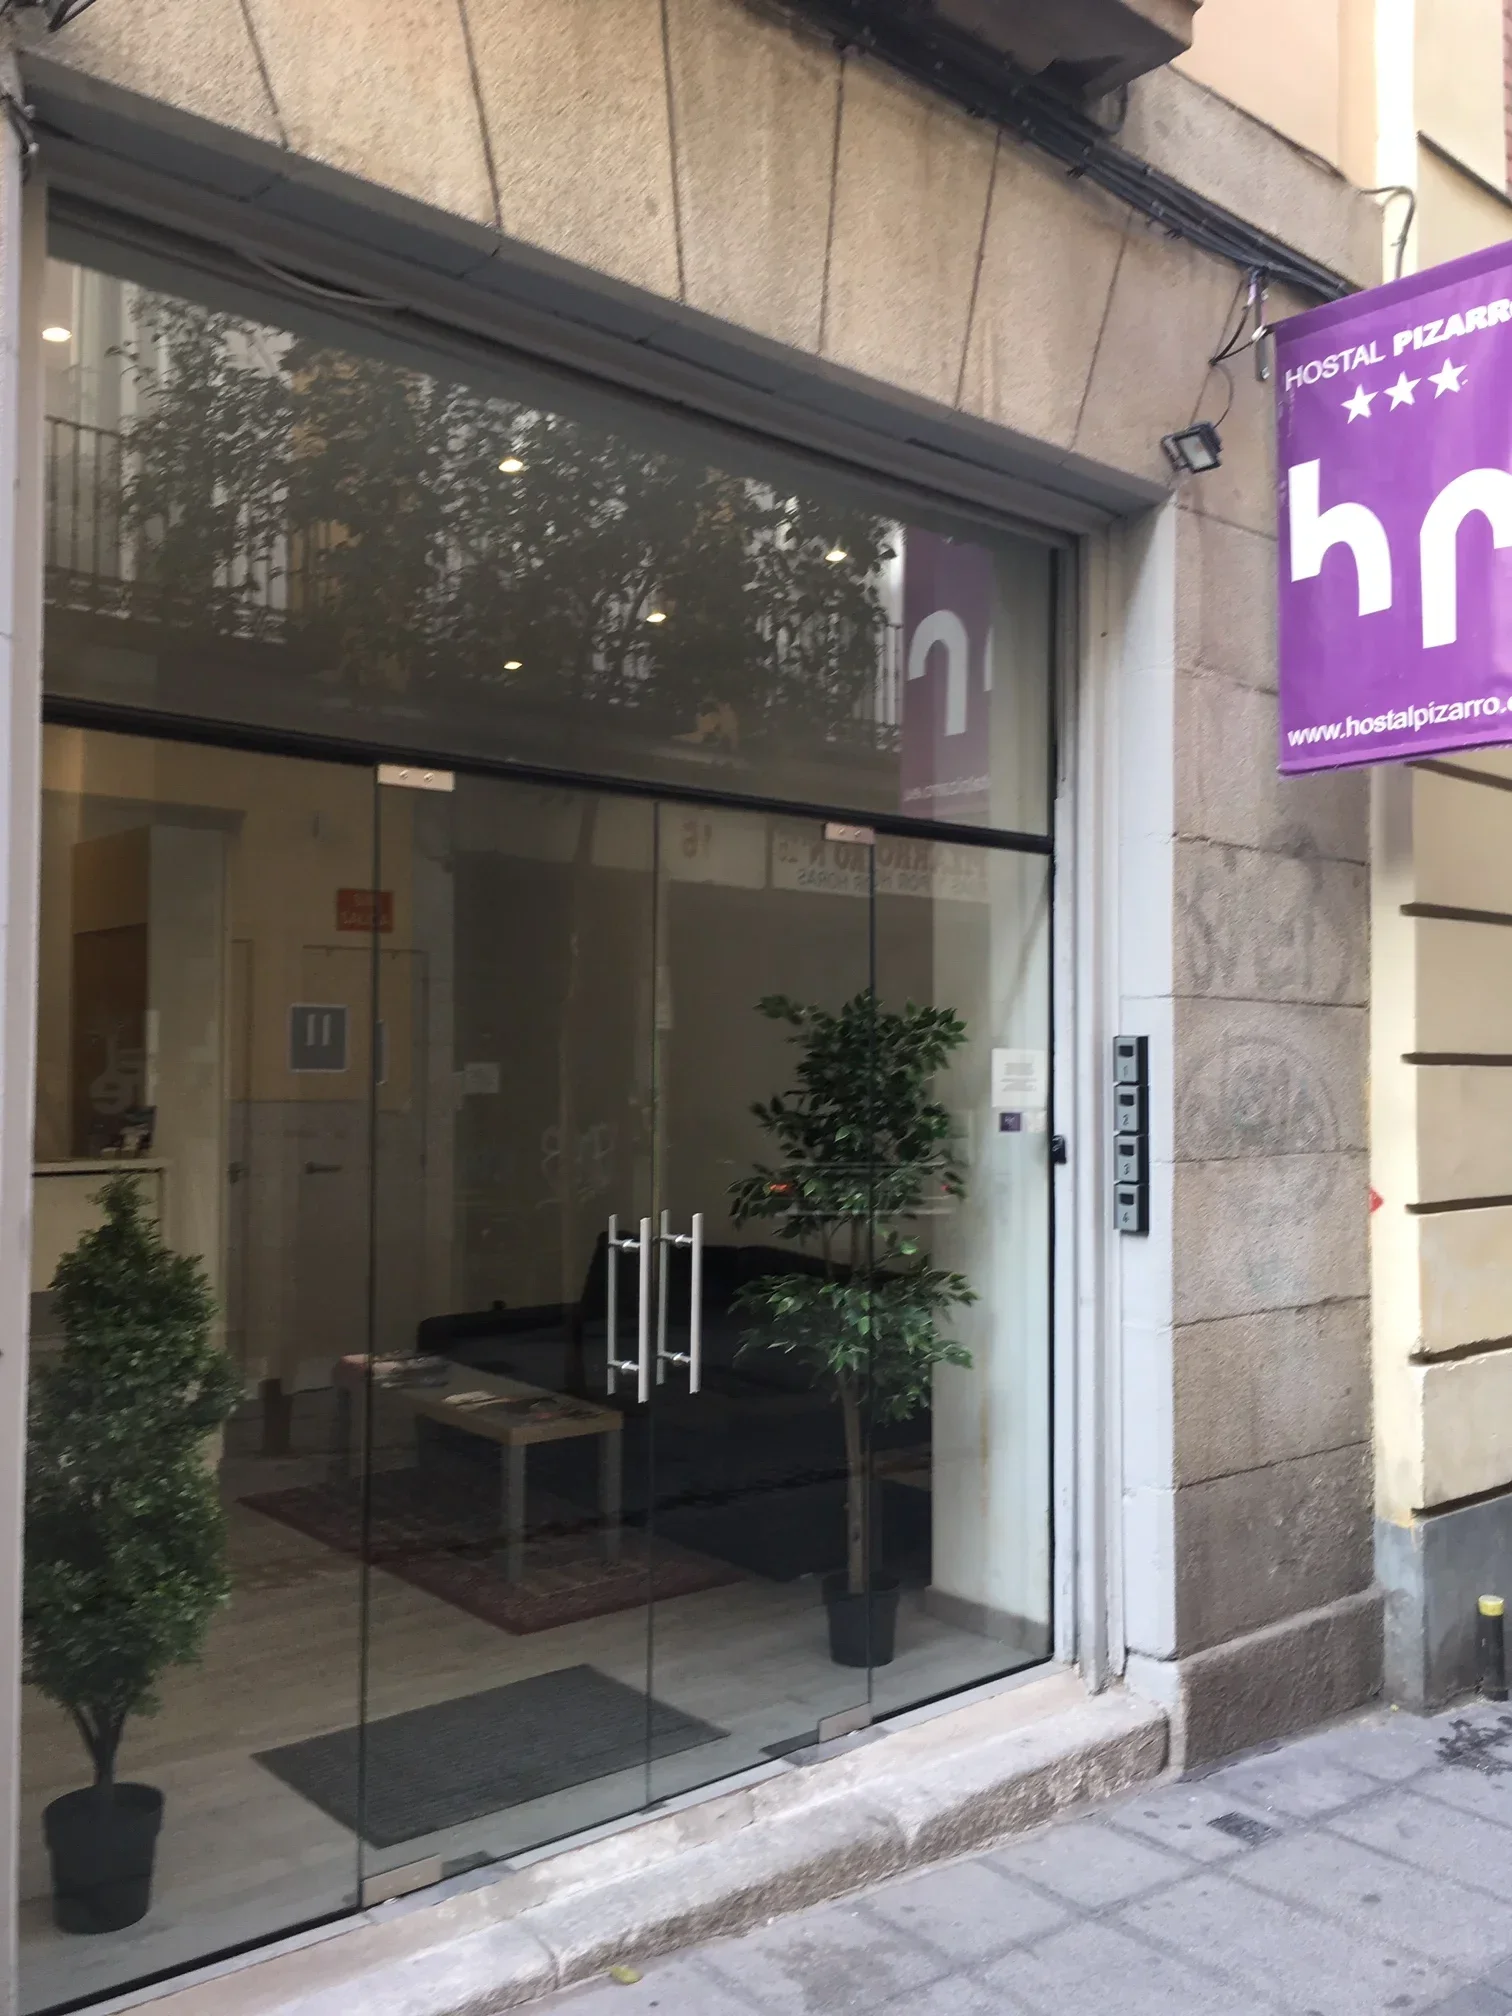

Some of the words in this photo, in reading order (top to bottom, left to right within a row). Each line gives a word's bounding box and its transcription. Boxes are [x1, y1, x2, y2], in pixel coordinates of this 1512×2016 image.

[1285, 340, 1386, 392] HOSTAL
[1393, 298, 1512, 356] PIZARR
[1122, 1113, 1130, 1126] 2
